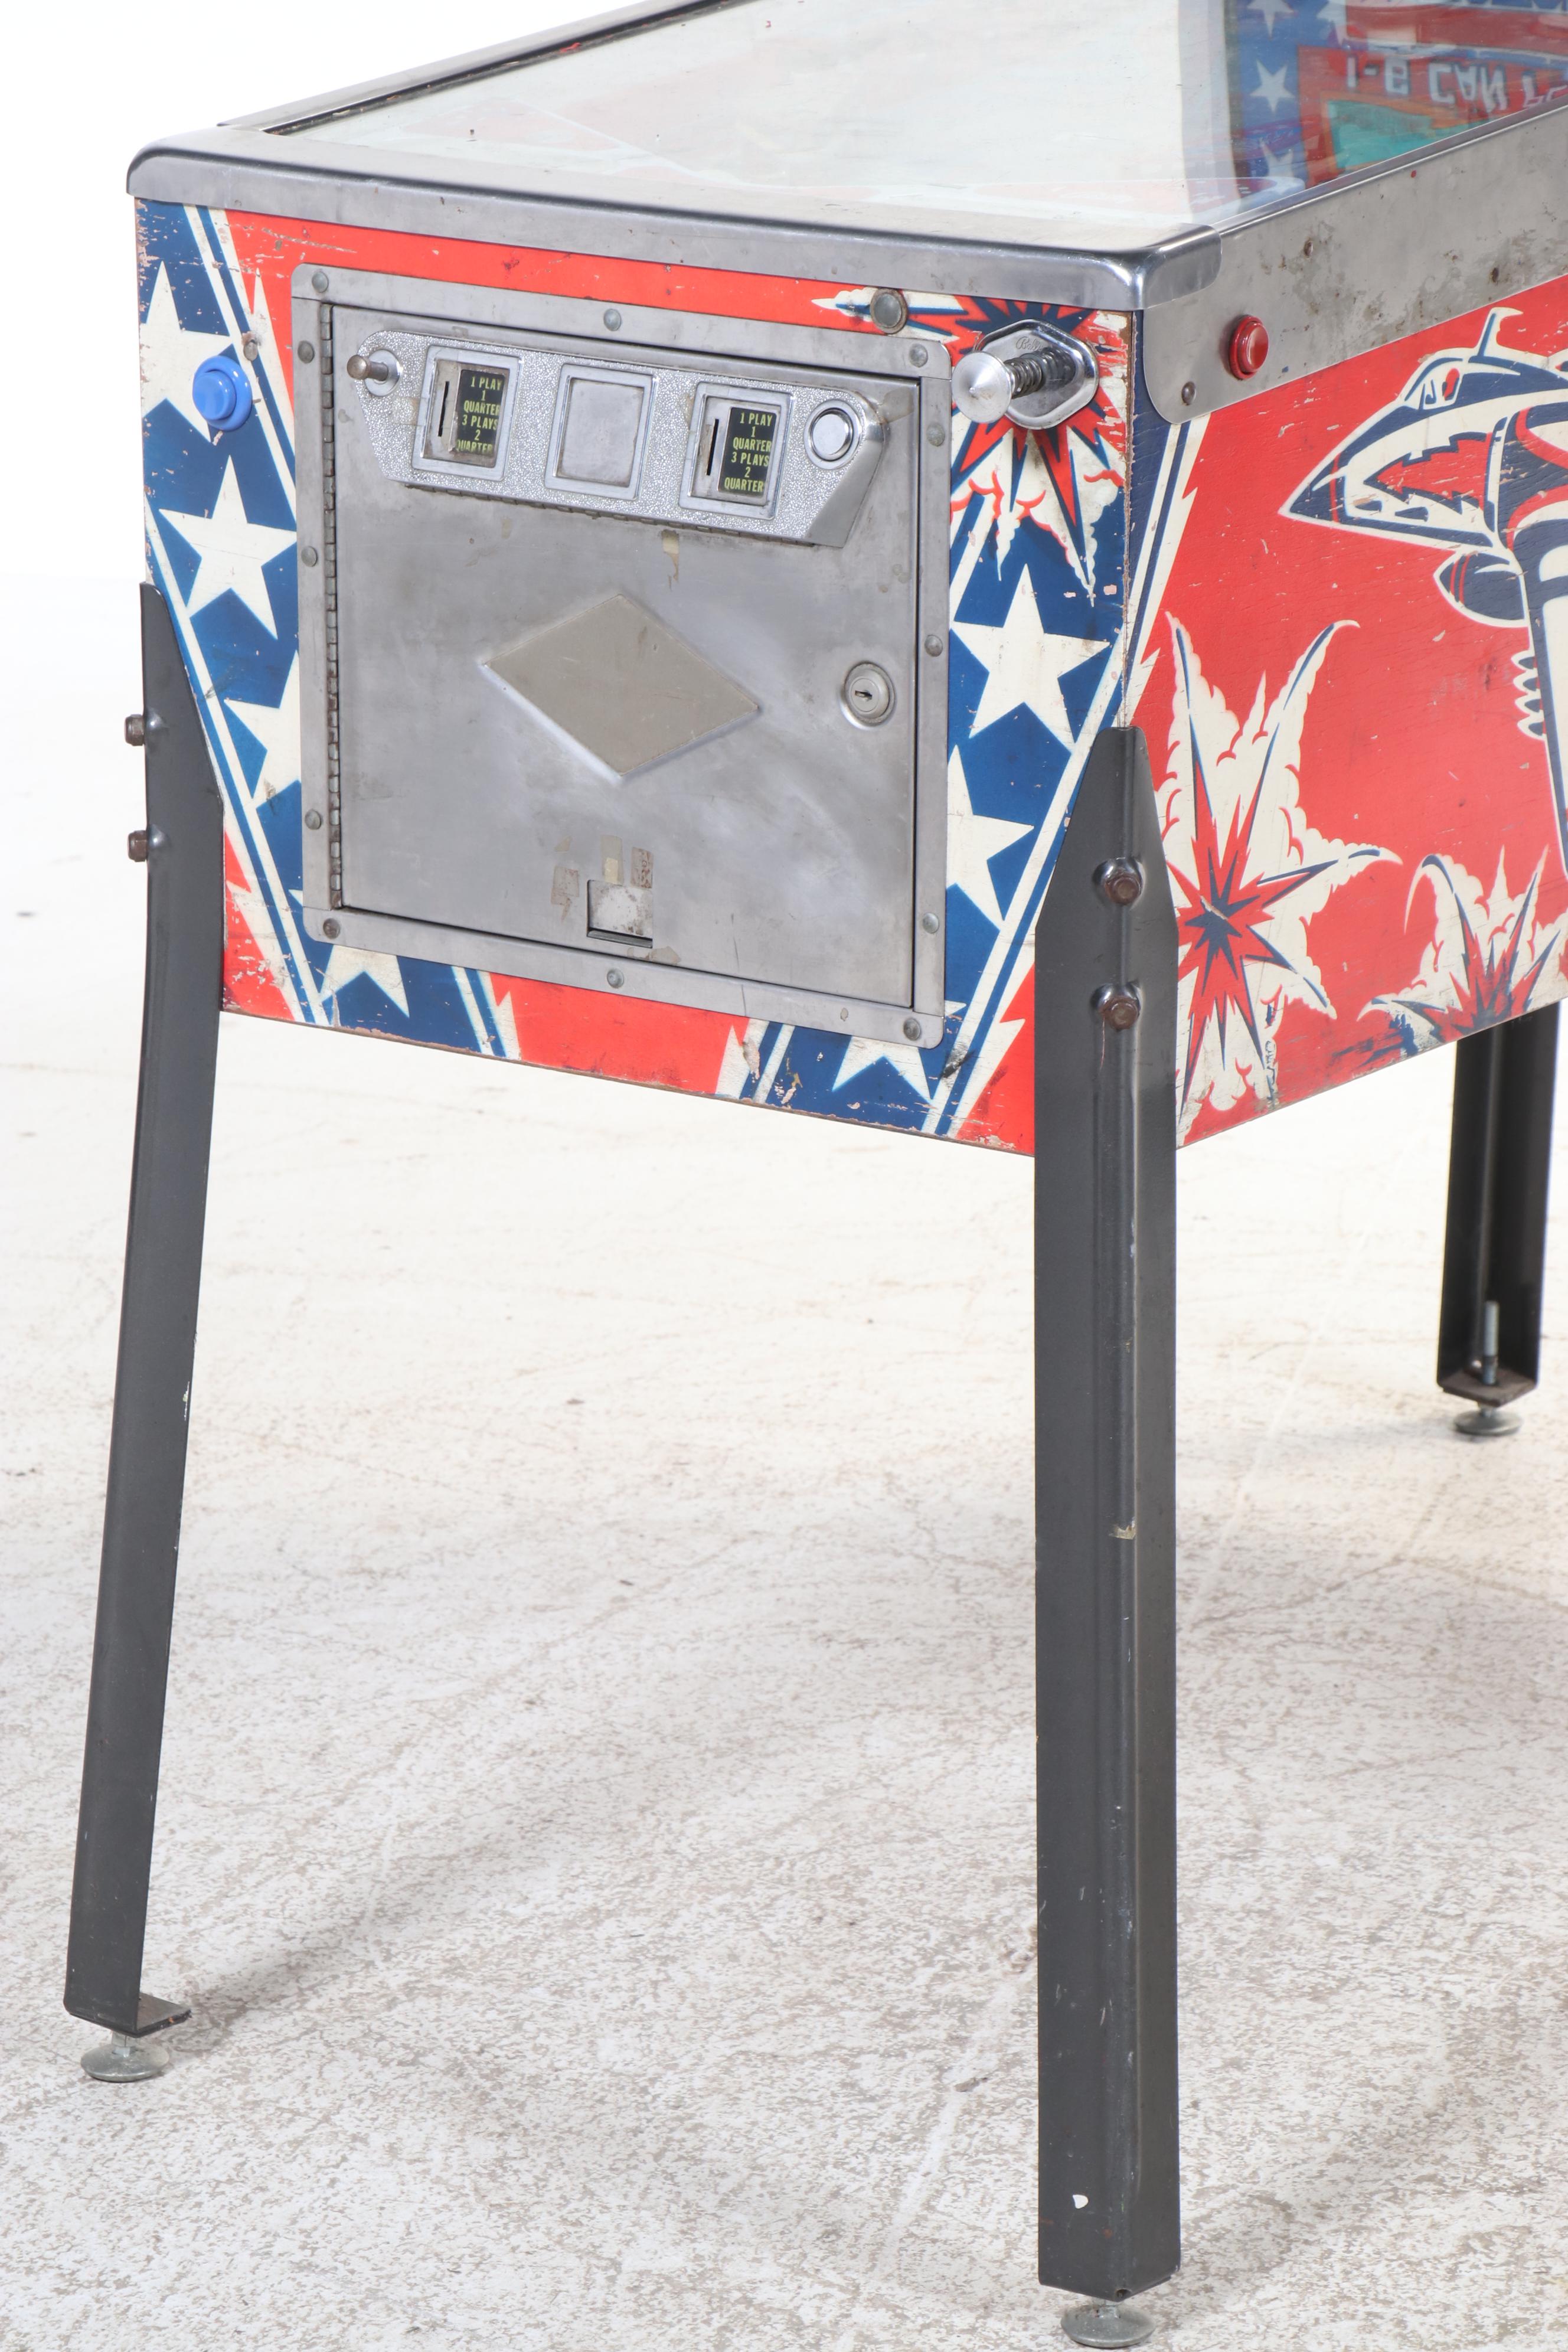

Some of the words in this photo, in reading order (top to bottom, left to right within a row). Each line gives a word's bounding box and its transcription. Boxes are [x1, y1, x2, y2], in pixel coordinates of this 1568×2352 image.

[471, 376, 476, 387] 1
[479, 377, 502, 391] PLAY
[481, 390, 486, 401] 1
[463, 400, 501, 416] QUARTER
[462, 414, 468, 426] 3
[471, 416, 498, 430] PLAYS
[740, 413, 744, 424] 1
[749, 413, 772, 426] PLAY
[475, 429, 481, 440] 2
[751, 426, 756, 437] 1
[733, 437, 772, 452] QUARTER
[731, 452, 737, 463] 3
[740, 452, 770, 467] PLAYS
[744, 466, 751, 478] 2
[724, 477, 764, 492] QUARTER
